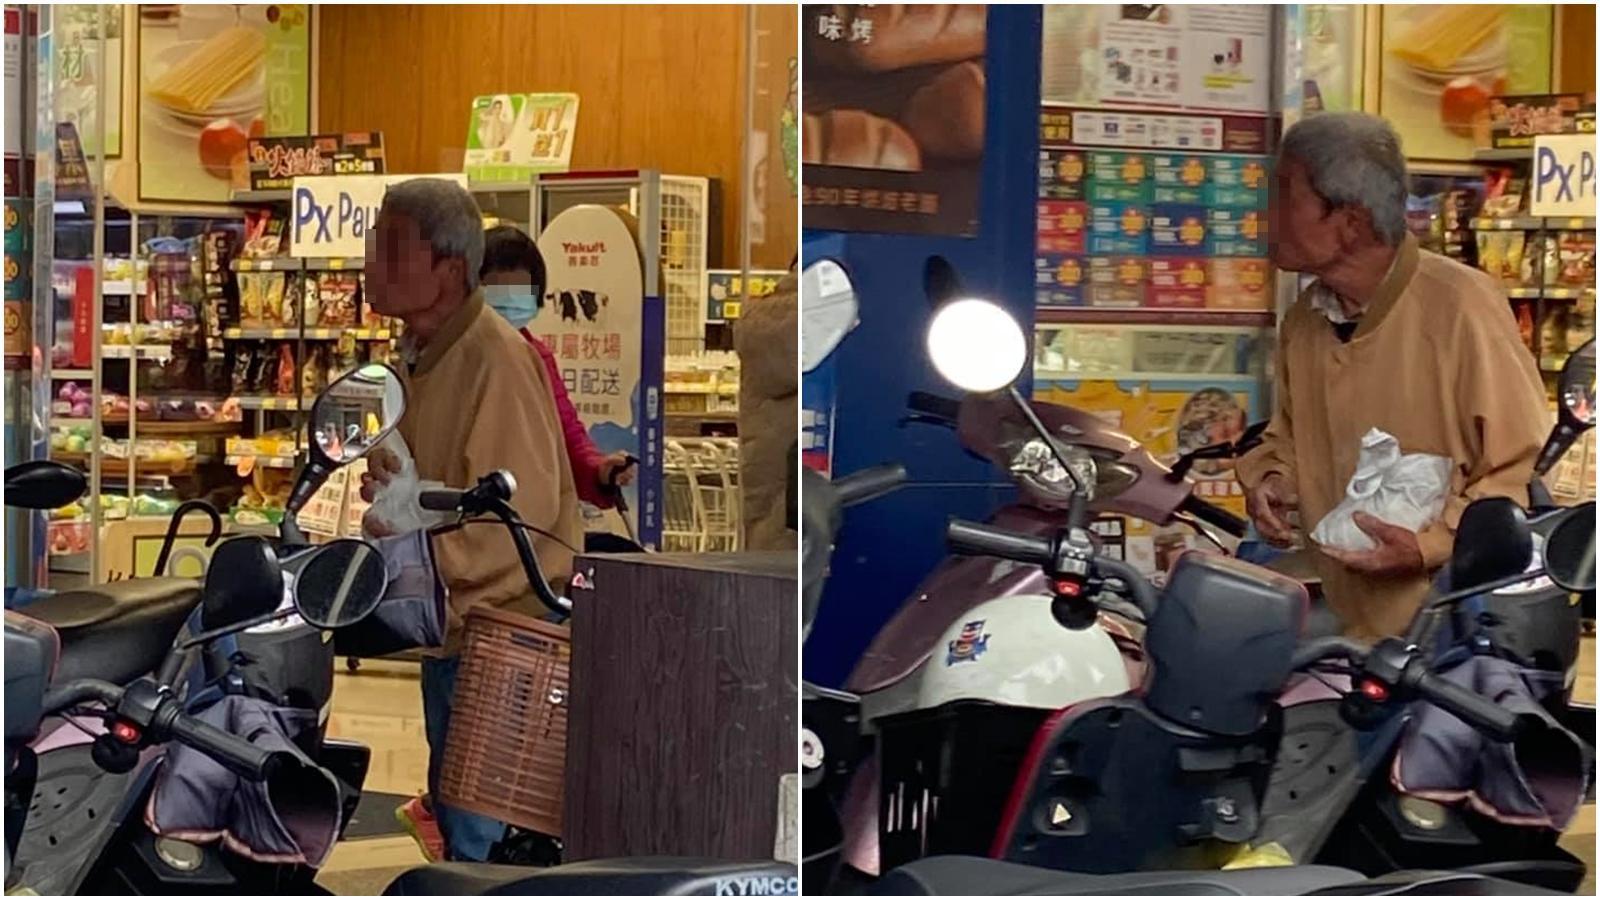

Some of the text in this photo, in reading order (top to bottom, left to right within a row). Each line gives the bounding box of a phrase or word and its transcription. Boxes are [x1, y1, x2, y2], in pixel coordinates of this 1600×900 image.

[1580, 151, 1596, 198] P
[562, 241, 606, 254] Yakult
[716, 877, 798, 896] KYMCO
